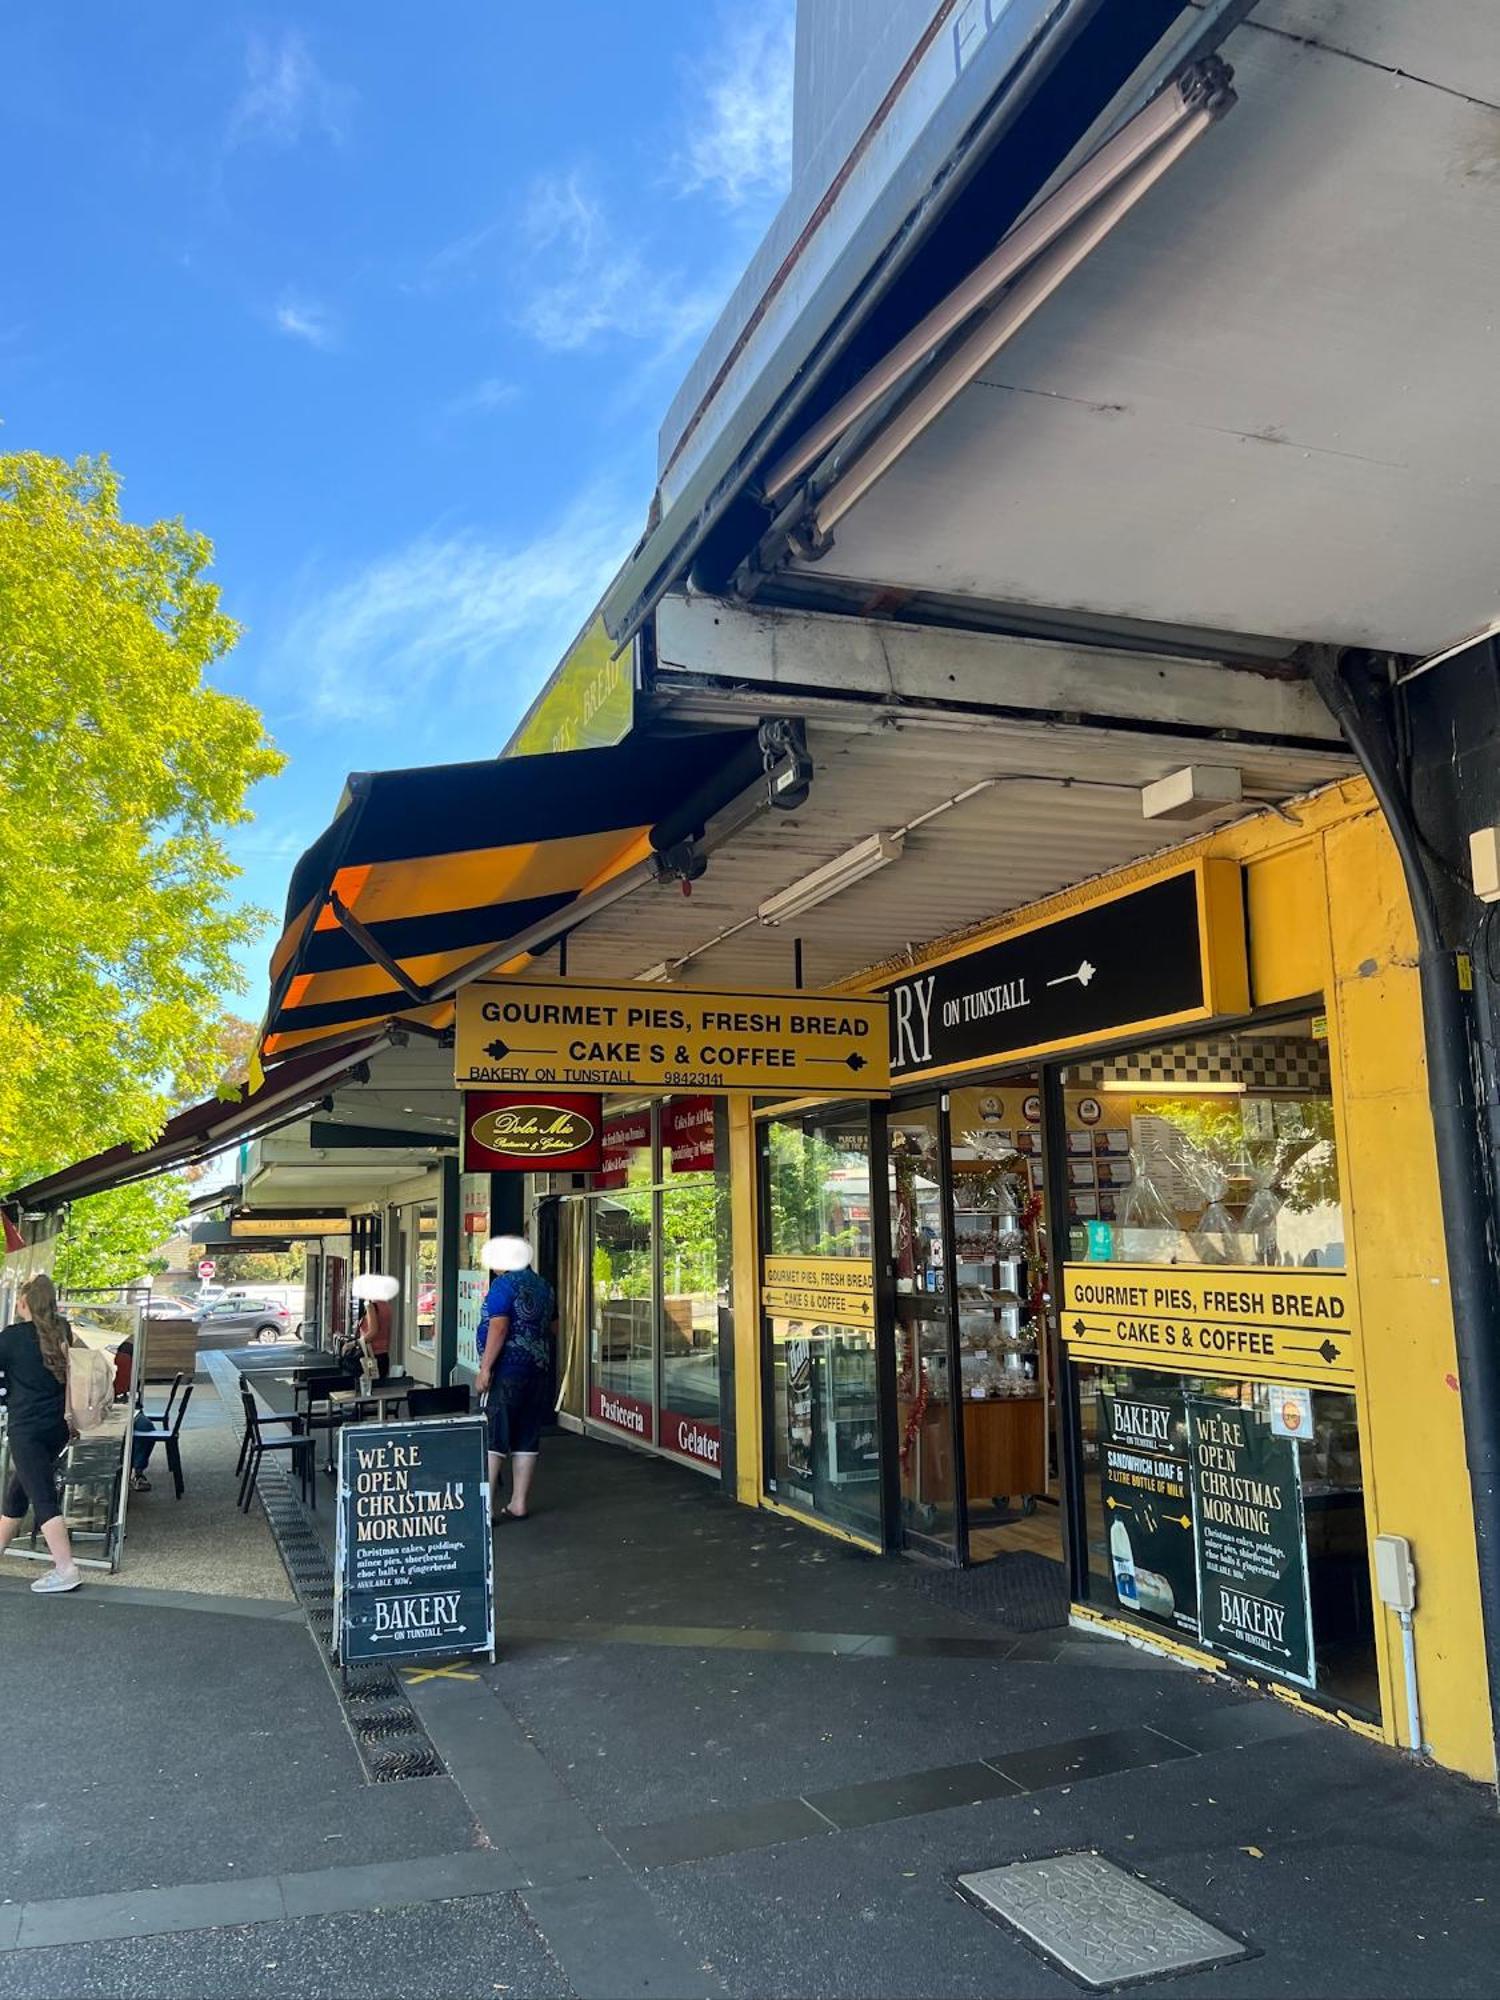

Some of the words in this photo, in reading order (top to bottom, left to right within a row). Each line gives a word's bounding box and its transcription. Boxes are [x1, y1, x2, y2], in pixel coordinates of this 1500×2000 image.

[943, 997, 960, 1027] ON
[962, 978, 1031, 1022] TUNSTALL
[482, 1002, 617, 1026] GOURMET
[628, 1008, 691, 1032] PIES,
[702, 1012, 780, 1033] FRESH
[790, 1015, 869, 1036] BREAD
[674, 1045, 690, 1064] &
[700, 1046, 795, 1067] COFFEE
[470, 1067, 528, 1080] BAKERY
[535, 1069, 555, 1081] ON
[563, 1069, 635, 1083] TUNSTALL
[664, 1072, 723, 1085] 98423141
[493, 1113, 538, 1134] Dolce
[540, 1114, 574, 1134] Mio
[768, 1270, 799, 1283] GOURMET
[801, 1272, 820, 1286] PIES,
[821, 1273, 845, 1286] FRESH
[847, 1275, 872, 1288] BREAD
[817, 1297, 846, 1311] COFFEE
[1074, 1284, 1148, 1307] GOURMET
[1154, 1288, 1197, 1314] PIES,
[1204, 1291, 1265, 1315] FRESH
[1272, 1294, 1345, 1319] BREAD
[1182, 1329, 1193, 1348] &
[1199, 1328, 1275, 1355] COFFEE
[601, 1394, 643, 1432] Pasticceria
[1113, 1403, 1171, 1440] BAKERY
[1196, 1413, 1244, 1447] WE'RE
[356, 1441, 422, 1469] WE'RE
[1199, 1444, 1236, 1472] OPEN
[357, 1470, 408, 1493] OPEN
[1154, 1461, 1175, 1479] LOAF
[1108, 1469, 1113, 1480] 2
[1113, 1470, 1131, 1485] LITRE
[1132, 1474, 1156, 1491] BOTTLE
[1157, 1479, 1165, 1493] OF
[1166, 1482, 1185, 1499] MILK
[1200, 1471, 1281, 1510] CHRISTMAS
[357, 1491, 464, 1517] CHRISTMAS
[1202, 1497, 1270, 1535] MORNING
[357, 1514, 447, 1542] MORNING
[1204, 1527, 1235, 1542] Christmas
[357, 1547, 399, 1559] Christmas
[357, 1559, 382, 1568] mince
[357, 1569, 375, 1578] choc
[378, 1567, 398, 1576] balls
[408, 1561, 457, 1575] gingerbread
[357, 1579, 392, 1588] AVAILABLE
[375, 1595, 461, 1631] BAKERY
[1220, 1591, 1285, 1642] BAKERY
[394, 1631, 405, 1640] ON
[407, 1628, 443, 1638] TUNSTALL
